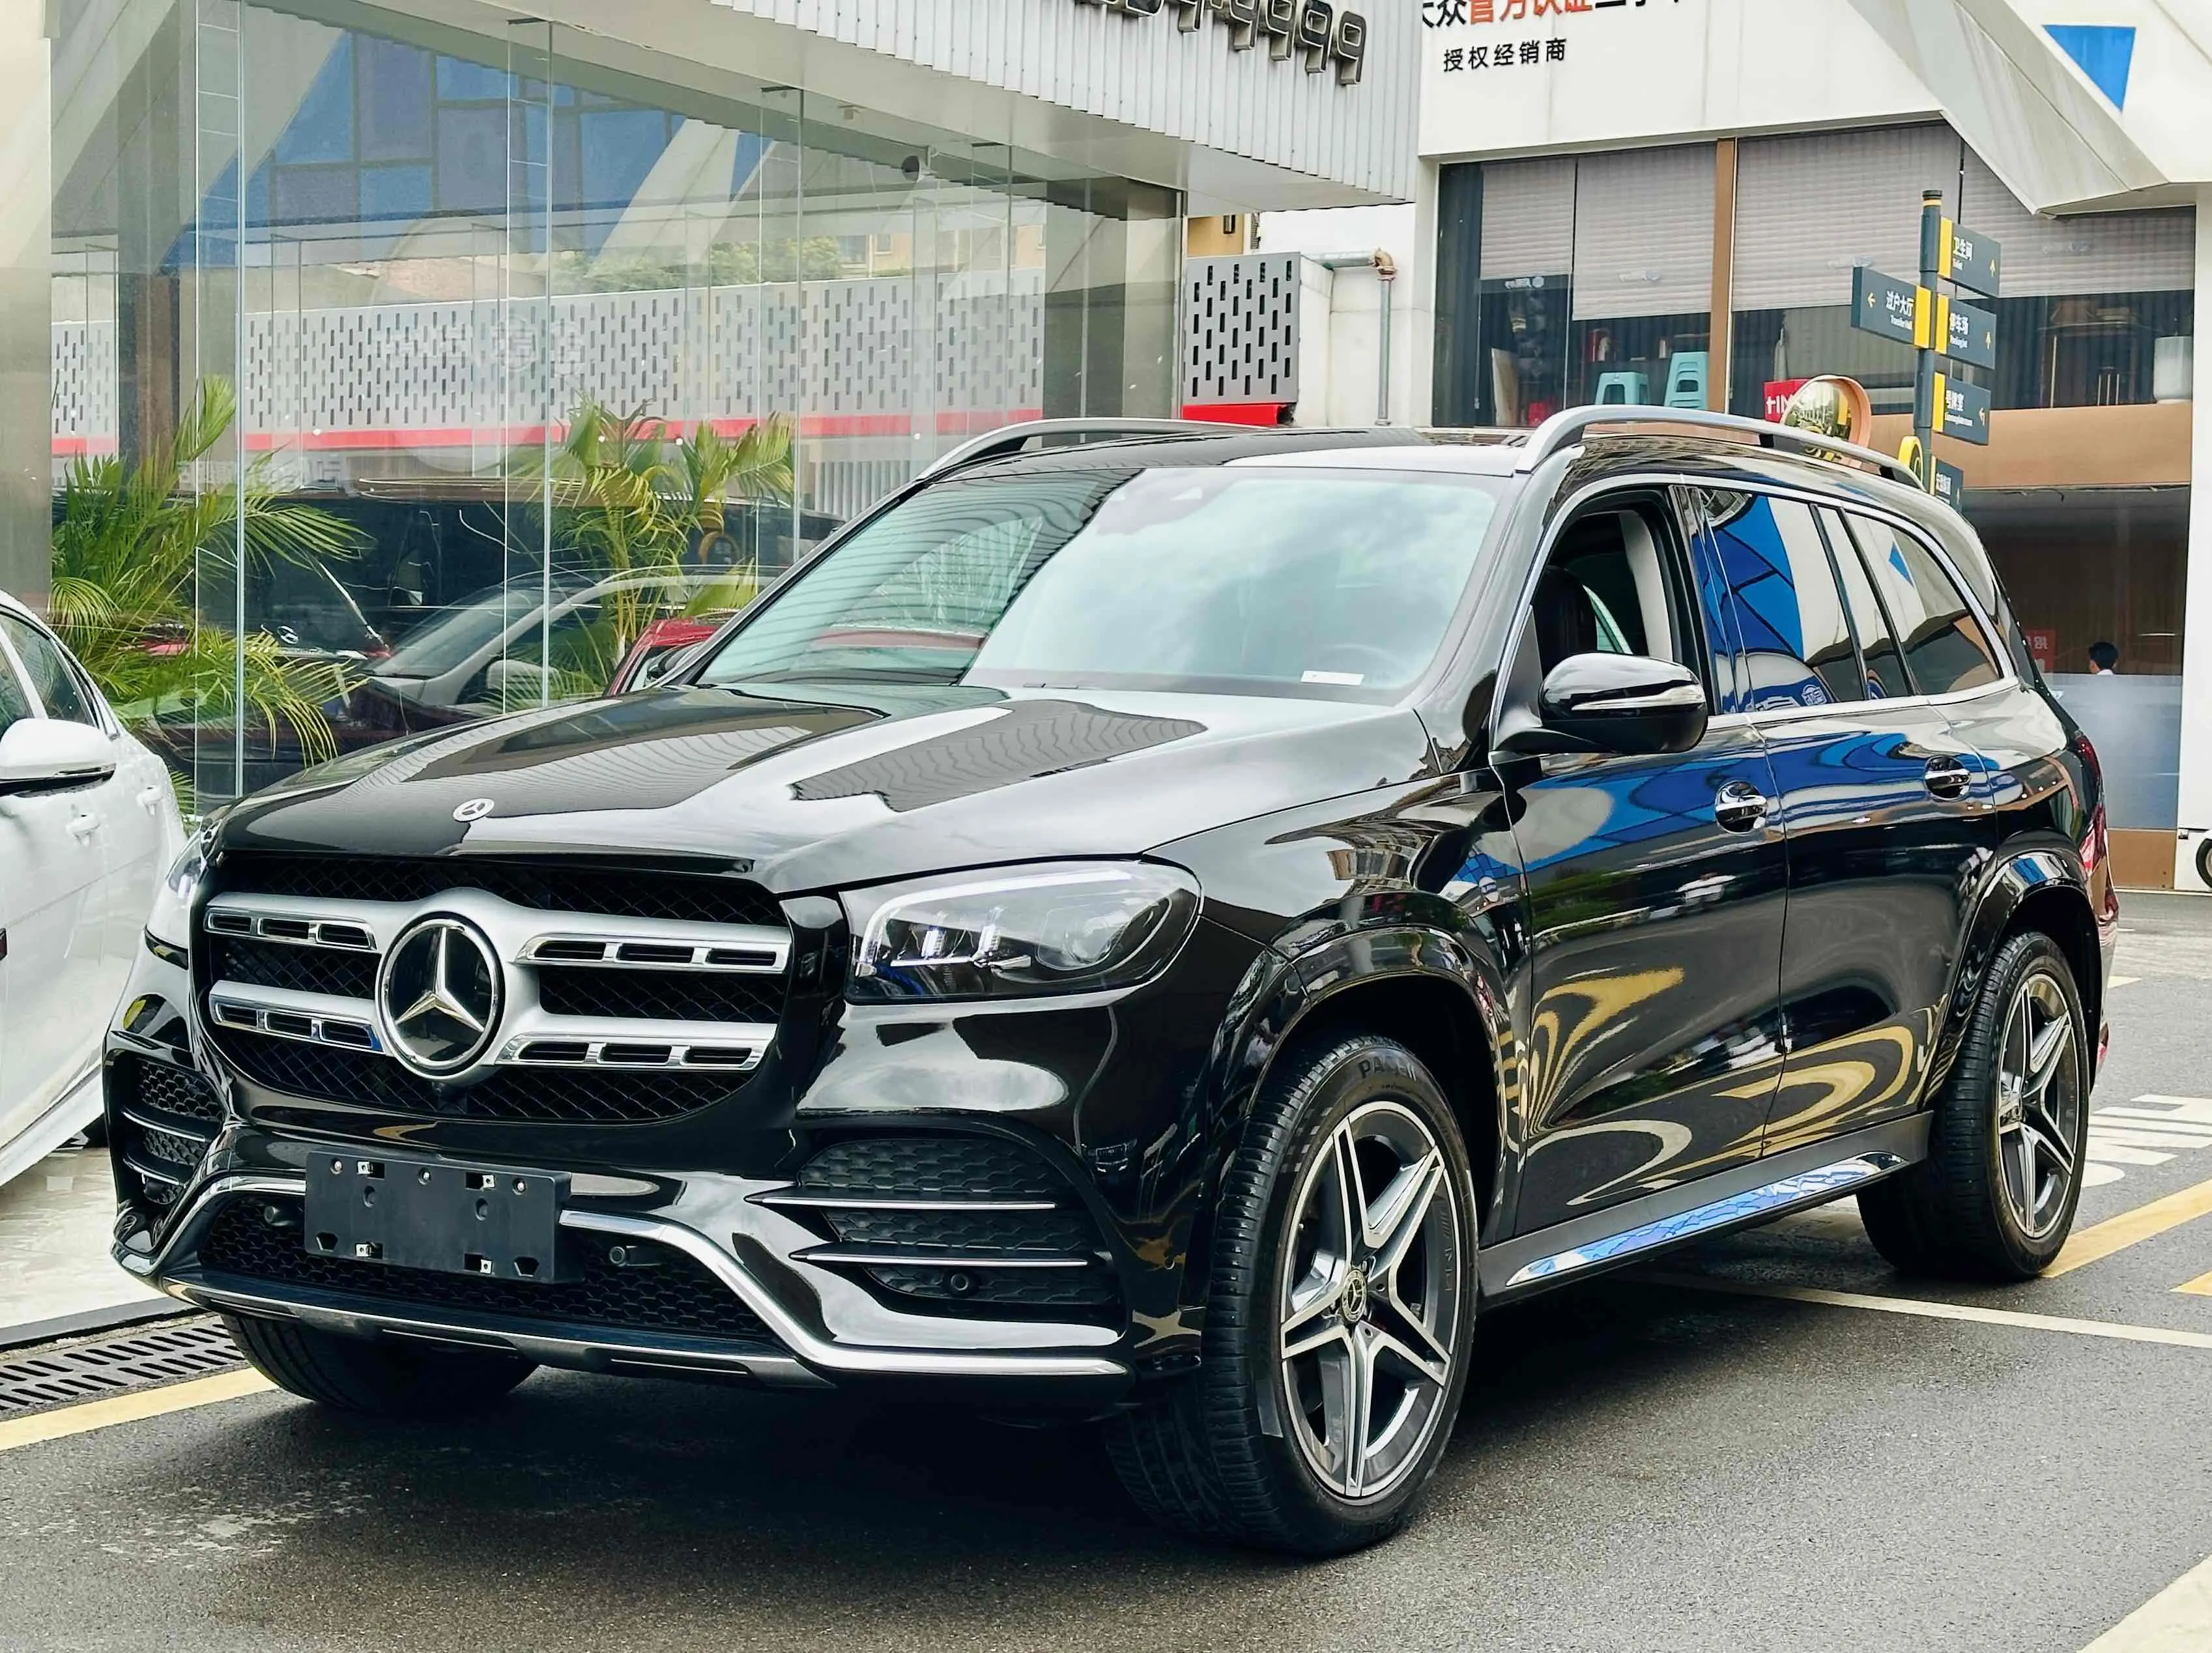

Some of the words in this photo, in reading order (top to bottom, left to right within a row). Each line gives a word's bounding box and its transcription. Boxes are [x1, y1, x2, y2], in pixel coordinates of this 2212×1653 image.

[1443, 37, 1567, 72] 授权经销商
[1886, 290, 1914, 317] 过户大厅
